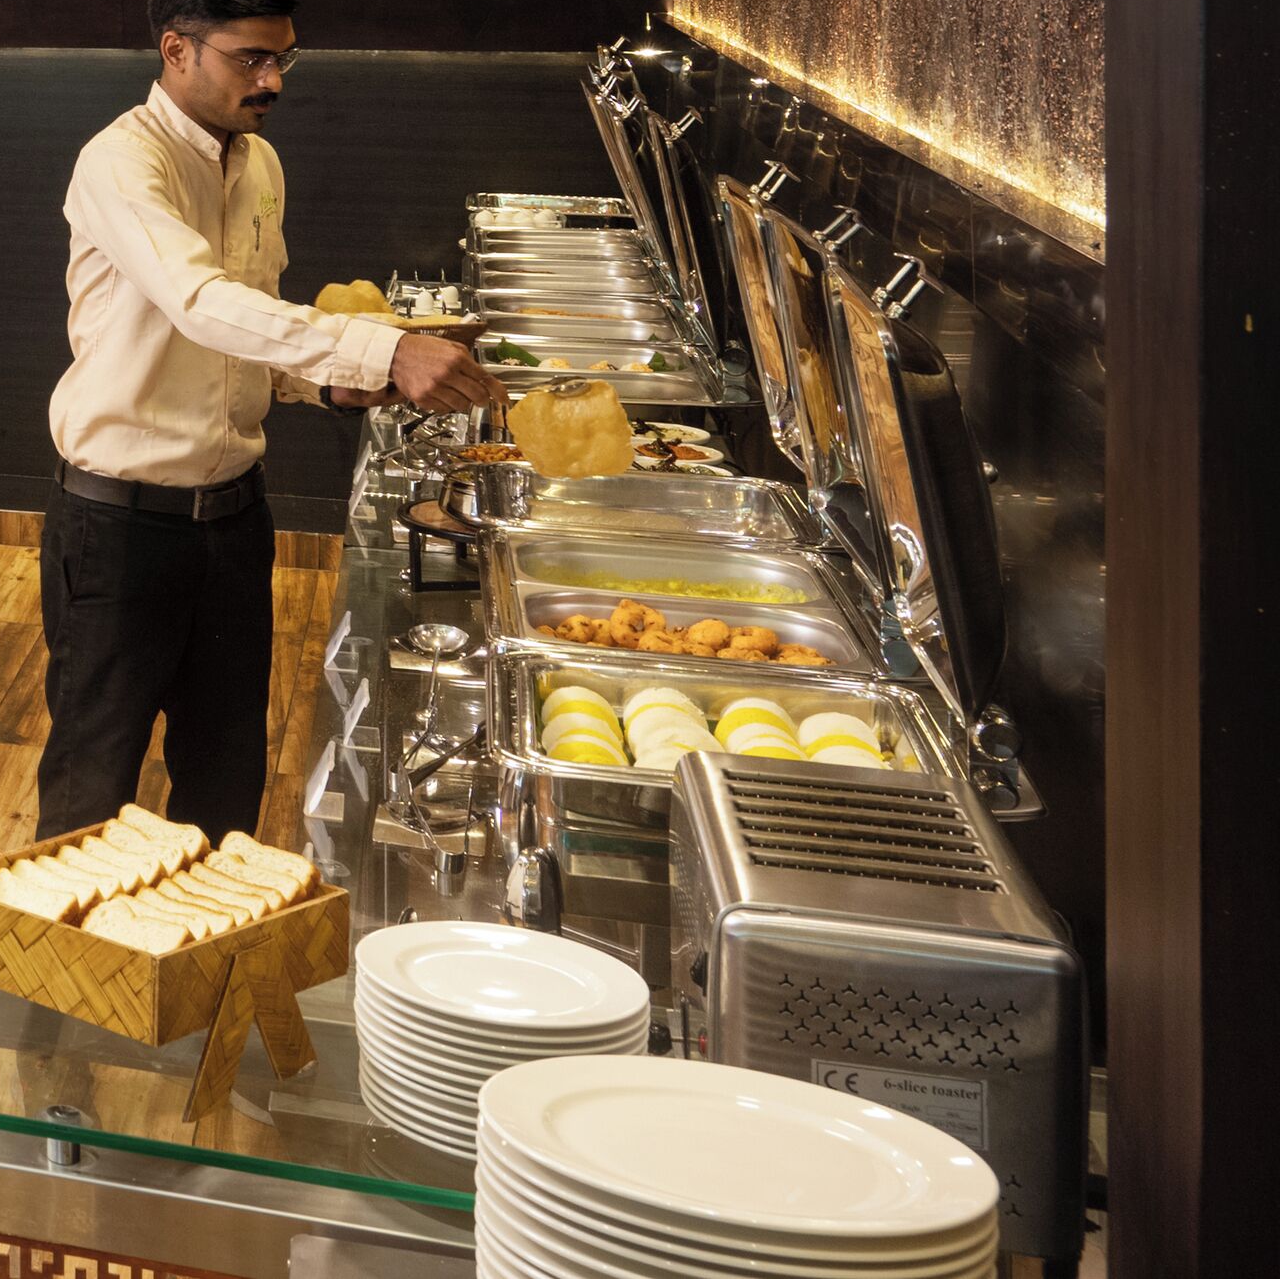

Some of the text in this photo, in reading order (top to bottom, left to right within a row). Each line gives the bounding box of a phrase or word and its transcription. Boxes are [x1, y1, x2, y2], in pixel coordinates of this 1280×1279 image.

[824, 1070, 858, 1094] CE
[883, 1078, 981, 1100] 6-slice toaster
